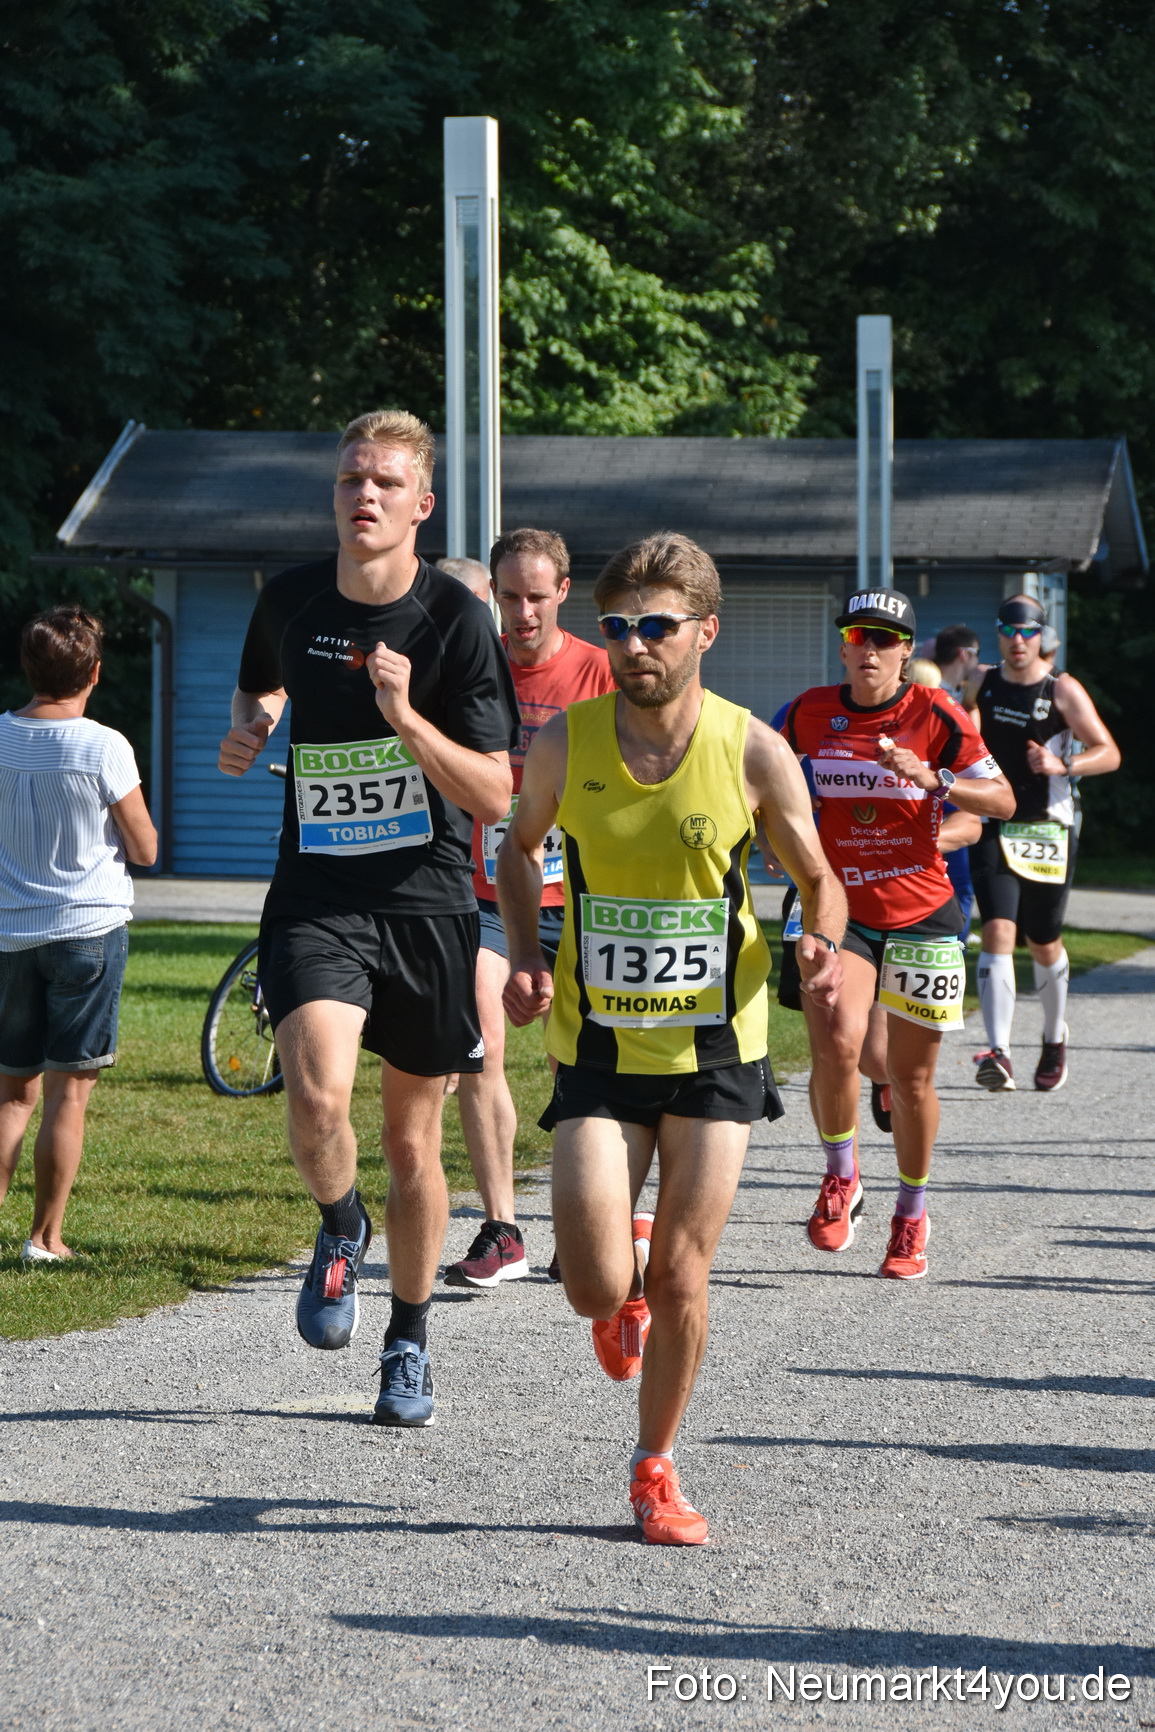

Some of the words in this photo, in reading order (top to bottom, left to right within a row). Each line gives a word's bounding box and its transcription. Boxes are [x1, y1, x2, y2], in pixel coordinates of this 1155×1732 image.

[849, 593, 907, 618] OAKLEY
[315, 635, 350, 647] APTIV
[307, 647, 333, 659] Running
[334, 652, 354, 661] Team
[300, 743, 409, 774] BOCK
[309, 775, 407, 817] 2357
[328, 821, 401, 842] TOBIAS
[690, 817, 707, 827] MTP
[1005, 823, 1061, 838] BOCK
[1009, 842, 1059, 861] 1232
[591, 900, 715, 934] BOCK
[598, 943, 708, 984] 1325
[891, 943, 962, 966] BOCK
[894, 971, 959, 1001] 1289
[602, 995, 698, 1012] THOMAS
[905, 1002, 948, 1020] VIOLA
